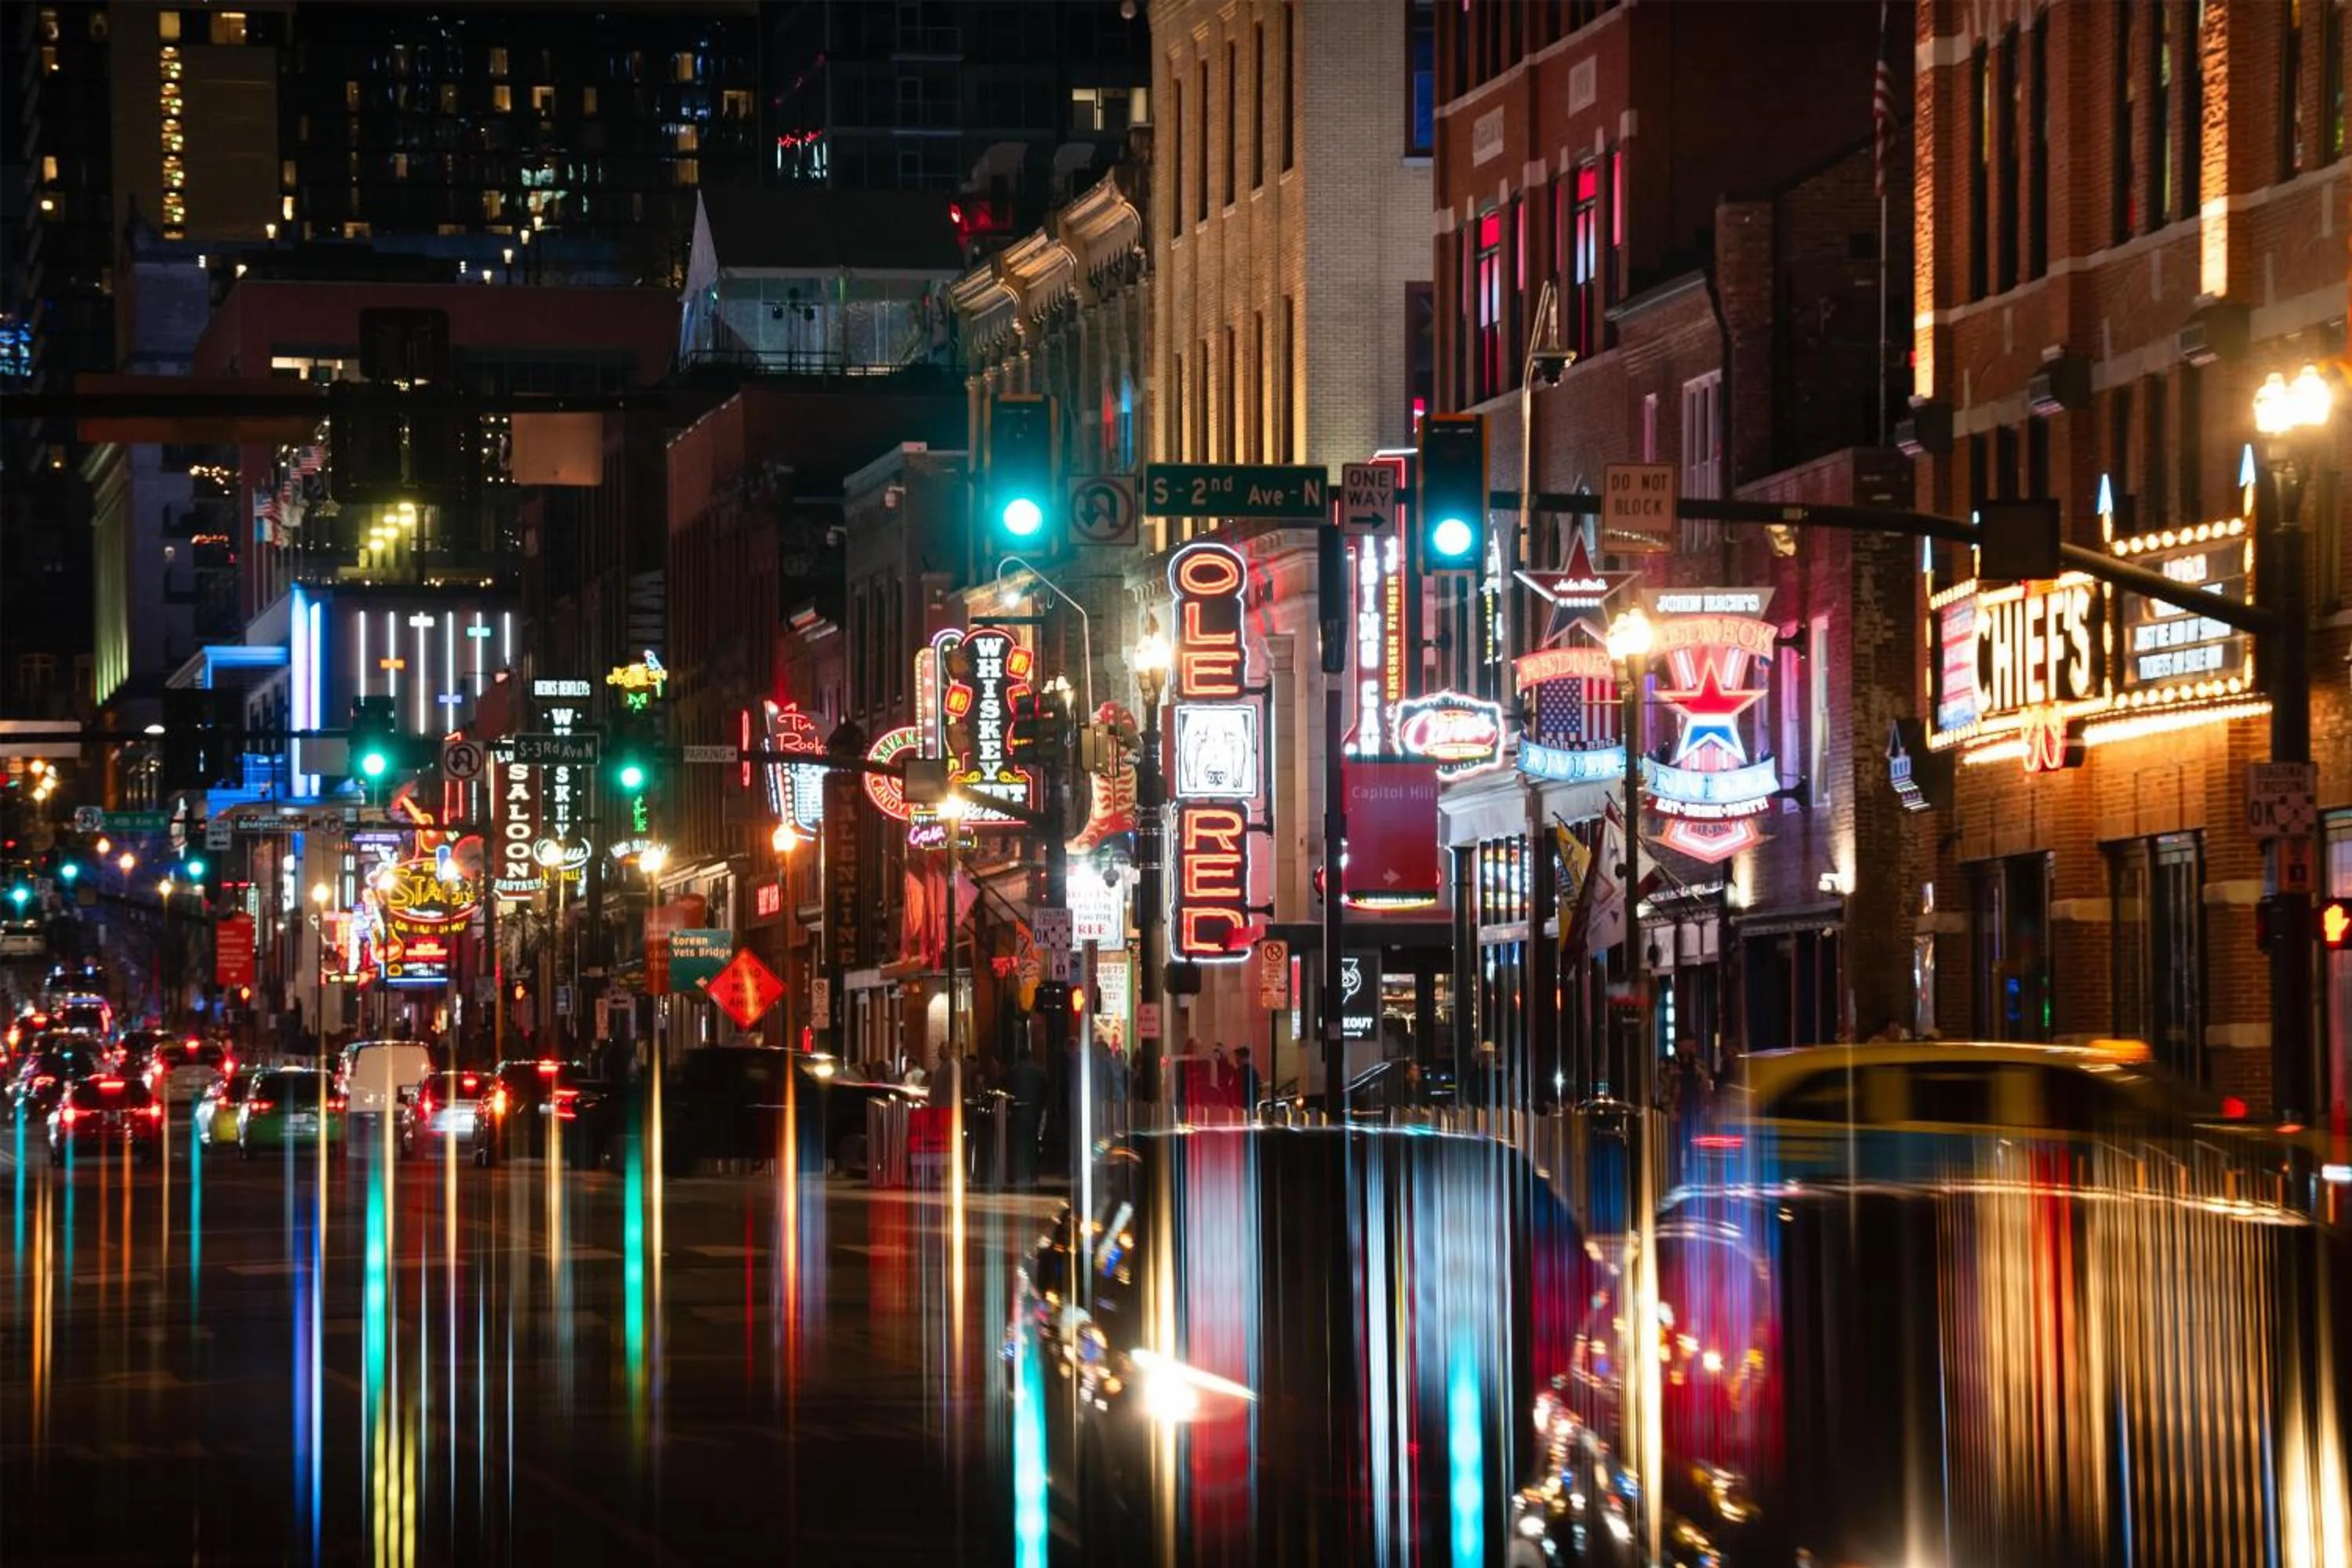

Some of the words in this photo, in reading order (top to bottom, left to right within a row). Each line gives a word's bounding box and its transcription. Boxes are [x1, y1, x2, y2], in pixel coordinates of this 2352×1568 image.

[1349, 470, 1388, 488] ONE
[1611, 474, 1630, 491] DO
[1642, 474, 1668, 491] NOT
[1348, 492, 1388, 507] WAY
[1615, 498, 1663, 516] BLOCK
[1179, 553, 1240, 696] OLE
[1972, 586, 2090, 713] CHIEF'S
[1523, 652, 1613, 682] REDNE
[777, 713, 815, 731] Tin
[975, 638, 1004, 780] WHISKEY
[684, 747, 727, 760] PARKING
[1526, 746, 1626, 777] RIVIER
[552, 708, 573, 840] WSKEY
[1352, 784, 1403, 801] Capitol
[1410, 785, 1435, 800] Hill
[506, 764, 532, 878] SALOON
[2249, 800, 2277, 827] OK
[837, 784, 856, 966] VALENTINE
[1181, 809, 1244, 953] RED
